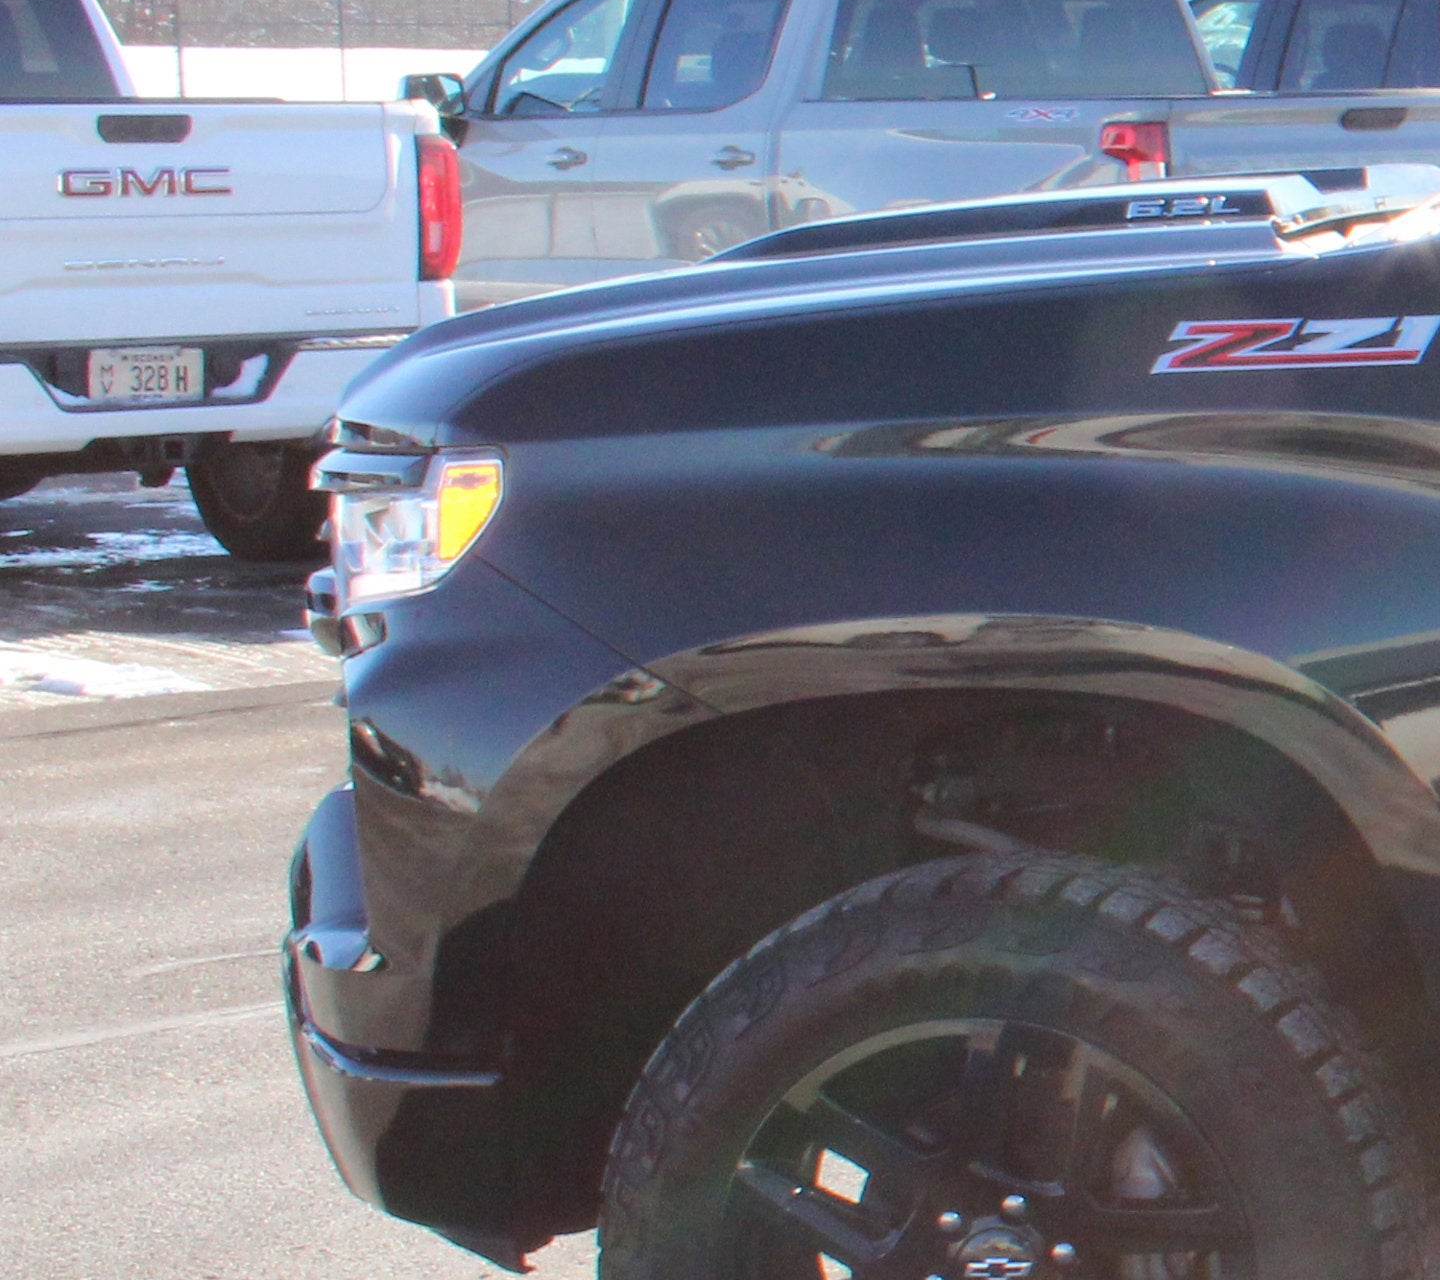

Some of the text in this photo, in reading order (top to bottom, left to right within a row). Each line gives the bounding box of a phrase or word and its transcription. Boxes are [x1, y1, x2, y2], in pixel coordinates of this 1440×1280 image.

[57, 166, 232, 198] GMC
[130, 365, 168, 392] 328
[176, 365, 188, 392] H
